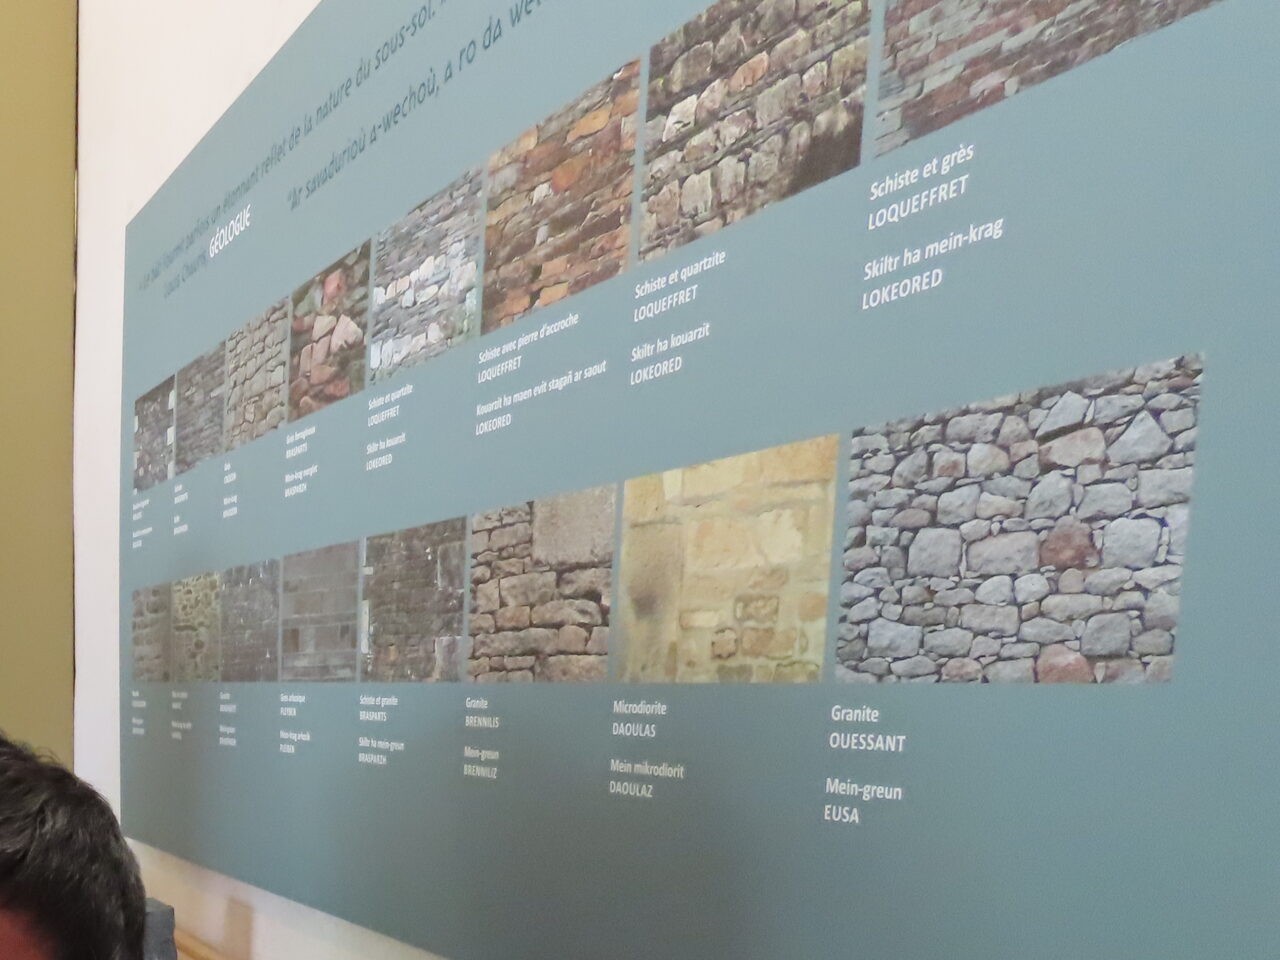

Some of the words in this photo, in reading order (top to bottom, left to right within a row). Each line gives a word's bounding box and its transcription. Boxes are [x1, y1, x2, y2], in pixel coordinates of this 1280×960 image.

[445, 60, 452, 83] a
[459, 40, 476, 72] ro
[482, 15, 502, 50] da
[289, 123, 300, 151] de
[316, 78, 352, 125] nature
[356, 57, 370, 87] du
[870, 168, 919, 200] Schiste
[922, 157, 938, 178] et
[941, 144, 974, 175] grès
[868, 174, 969, 230] LOQUEFFRET
[209, 204, 251, 258] GÉOLOGUE
[864, 255, 900, 280] Skiltr
[903, 248, 920, 267] ha
[924, 218, 1004, 259] mein-krag
[635, 276, 667, 299] Schiste
[668, 270, 679, 285] et
[680, 251, 726, 282] quartzite
[862, 268, 943, 310] LOKEORED
[634, 284, 698, 322] LOQUEFFRET
[478, 346, 501, 364] Schiste
[501, 340, 517, 354] avec
[517, 330, 539, 350] pierre
[632, 342, 655, 362] Skiltr
[657, 338, 668, 353] ha
[670, 322, 710, 348] kouarzit
[478, 356, 522, 384] LOQUEFFRET
[630, 356, 682, 385] LOKEORED
[476, 396, 502, 416] Kouarzit
[503, 395, 512, 406] ha
[533, 381, 547, 396] evit
[574, 371, 582, 382] ar
[584, 360, 606, 378] saout
[476, 413, 512, 436] LOKEORED
[465, 697, 488, 708] Granite
[613, 700, 667, 715] Microdiorite
[831, 705, 879, 722] Granite
[465, 716, 500, 728] BRENNILIS
[612, 722, 656, 737] DAOULAS
[829, 732, 906, 752] OUESSANT
[610, 759, 632, 773] Mein
[634, 761, 684, 778] mikrodiorit
[610, 781, 653, 797] DAOULAZ
[826, 778, 902, 800] Mein-greun
[824, 804, 859, 824] EUSA
